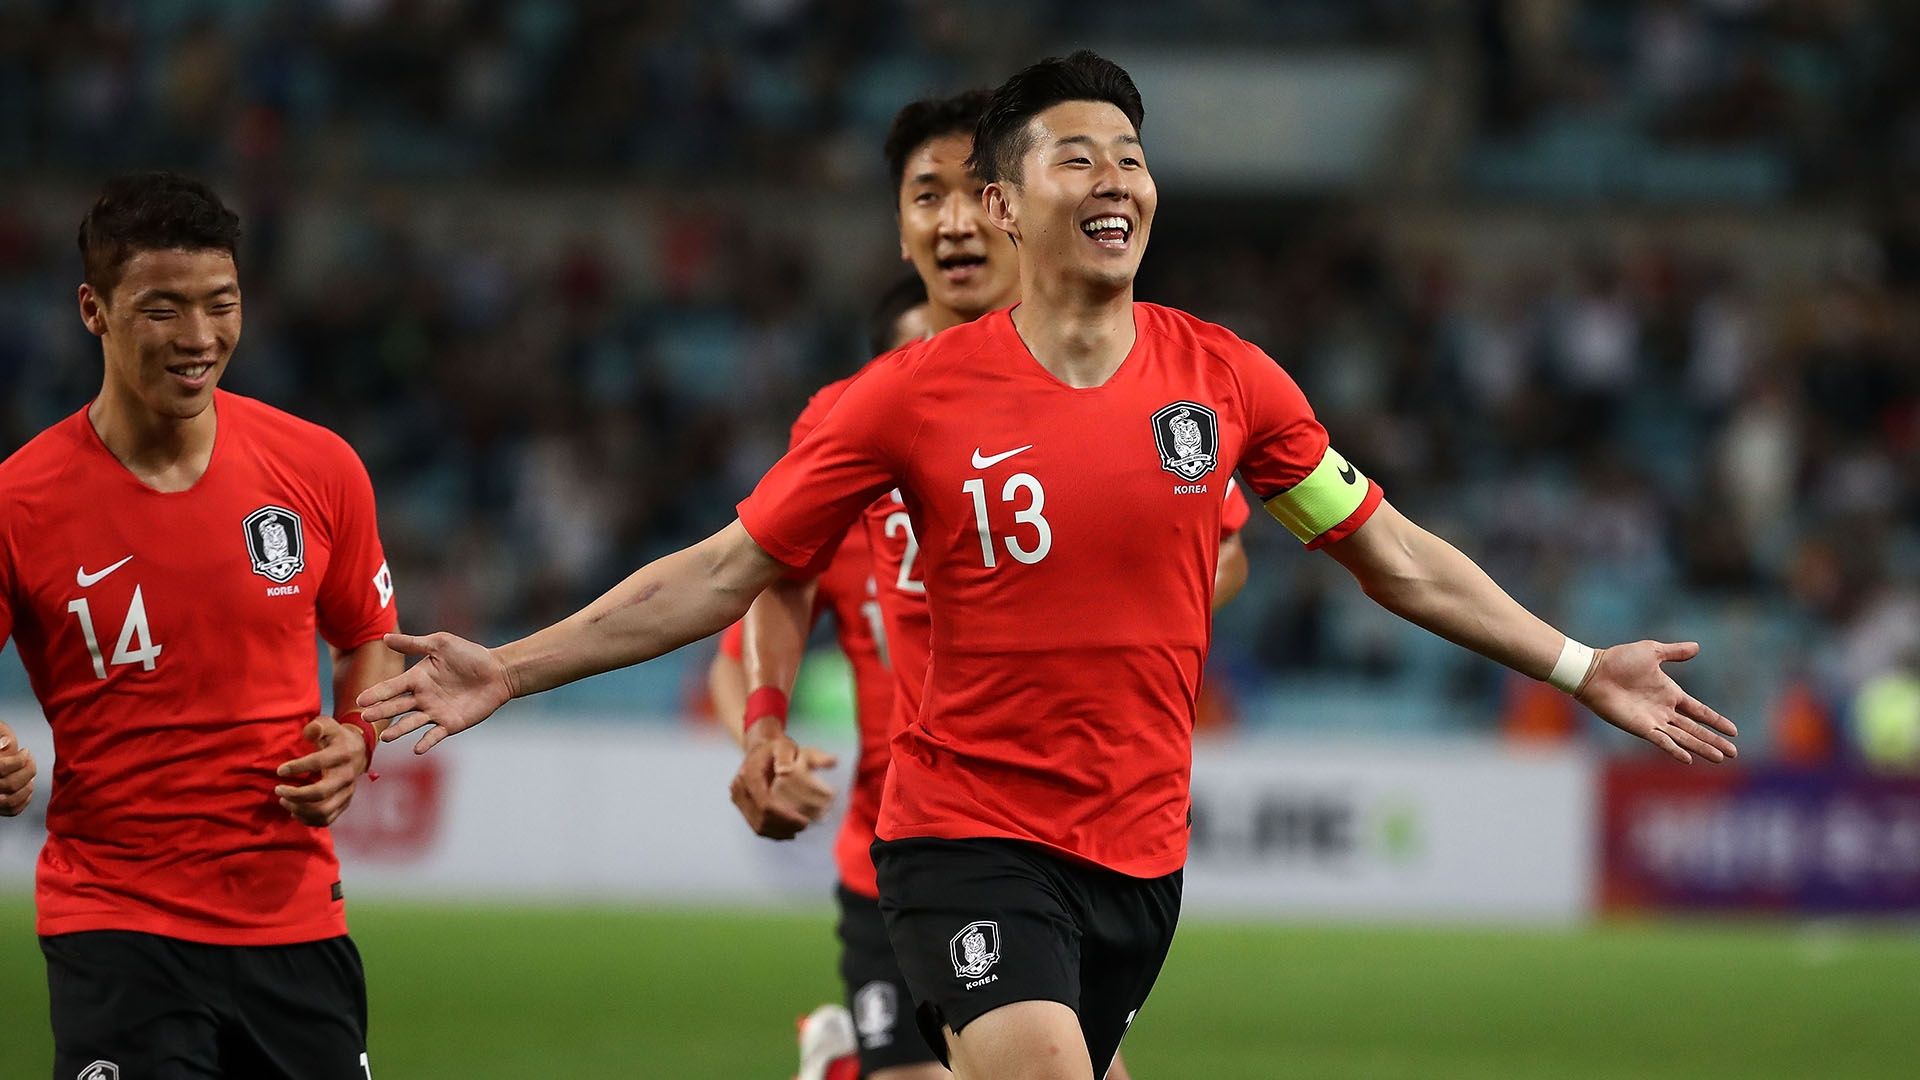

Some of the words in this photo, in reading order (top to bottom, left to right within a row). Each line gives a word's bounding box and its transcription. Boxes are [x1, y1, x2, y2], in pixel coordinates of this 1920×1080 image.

[1173, 484, 1208, 495] KOREA
[962, 472, 1052, 568] 13
[884, 512, 926, 593] 2
[266, 585, 301, 597] KOREA
[67, 583, 162, 680] 14
[965, 973, 999, 991] KOREA
